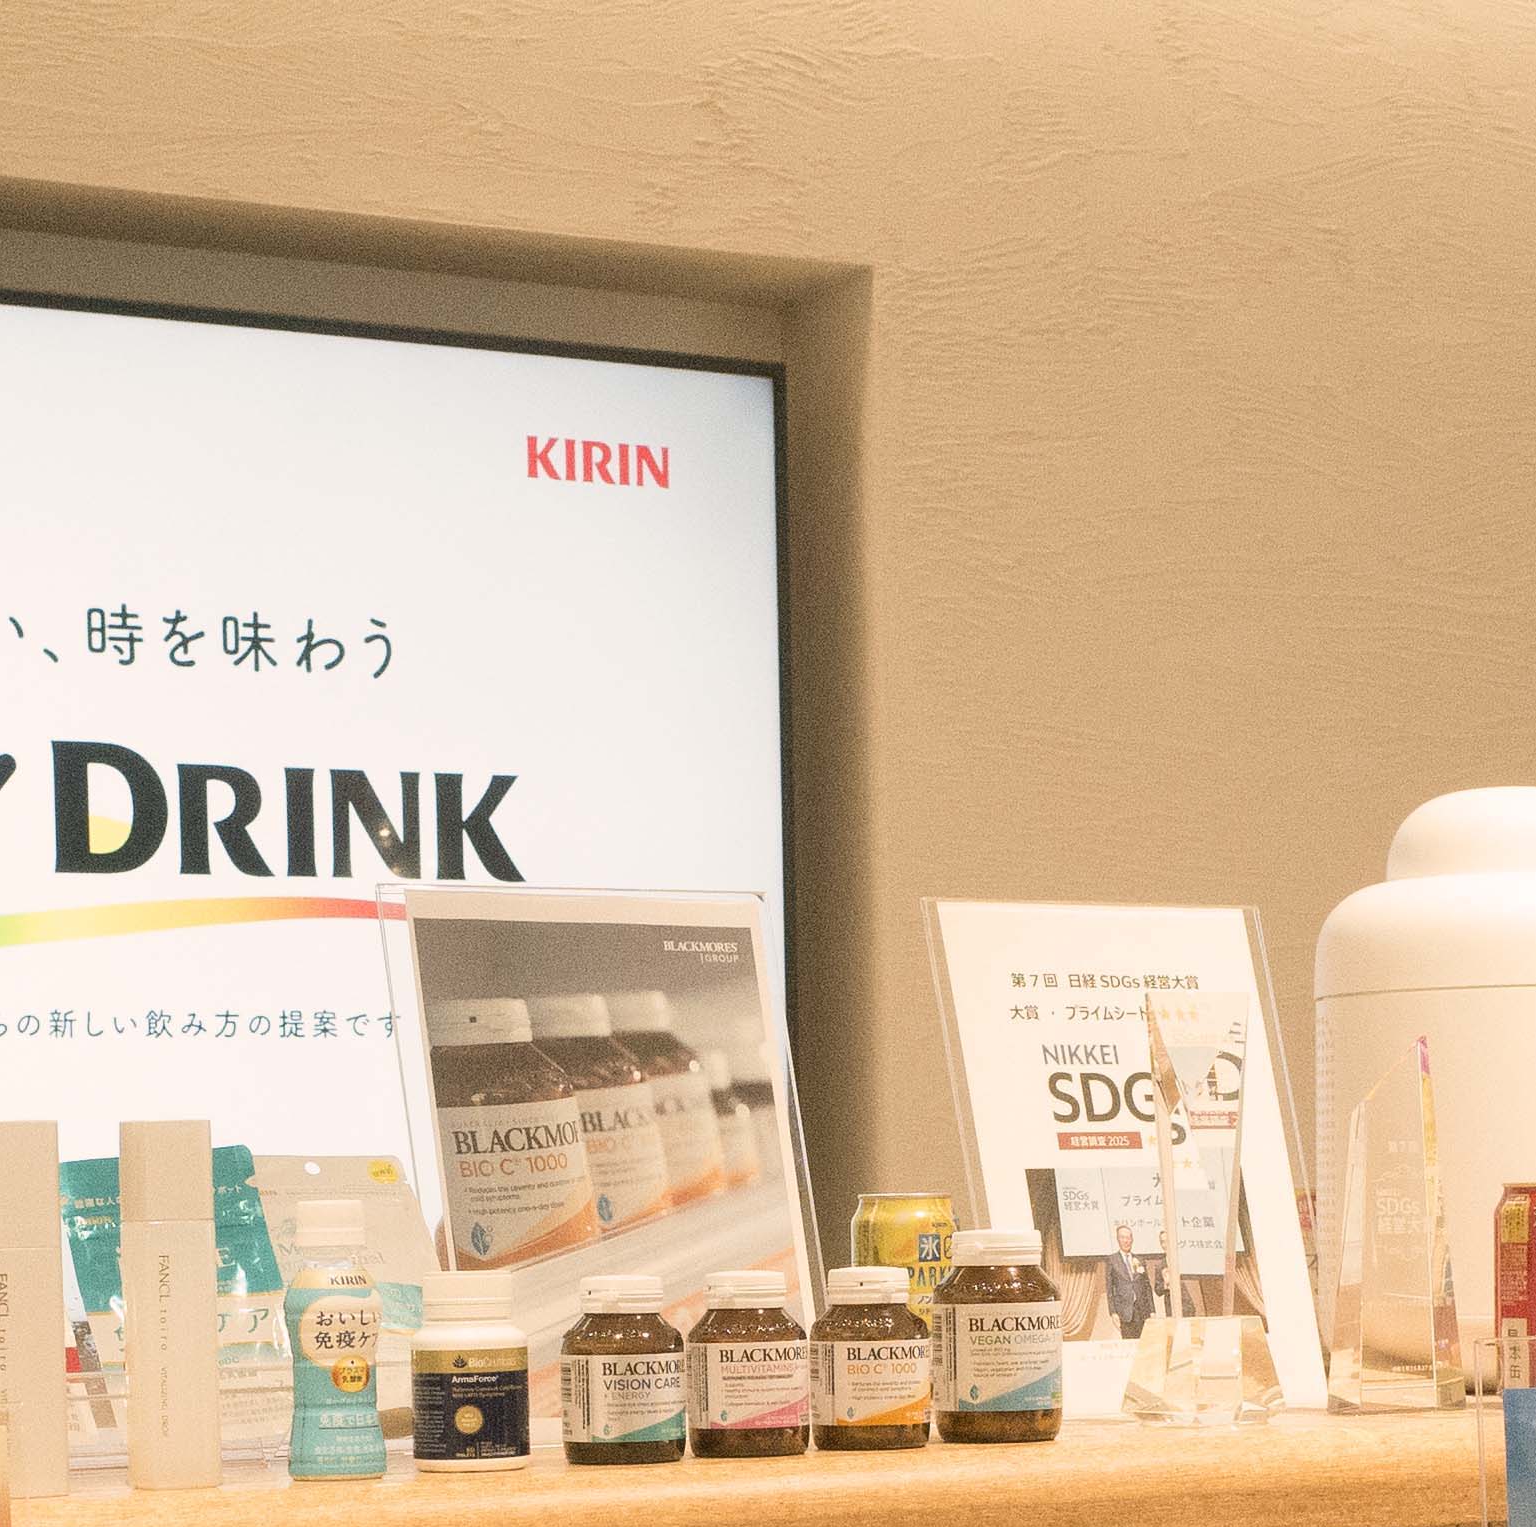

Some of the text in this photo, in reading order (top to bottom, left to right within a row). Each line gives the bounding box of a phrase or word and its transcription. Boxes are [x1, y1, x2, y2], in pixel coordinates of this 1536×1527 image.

[525, 433, 670, 490] KIRIN
[53, 739, 527, 882] DRINK
[663, 939, 739, 955] BLACKMORES
[704, 953, 740, 963] GROUP
[1068, 974, 1097, 990] 日経
[1100, 974, 1141, 991] SDGs
[1041, 1044, 1120, 1066] NIKKEI
[459, 1158, 496, 1179] BIO
[526, 1152, 569, 1174] 1000
[919, 1235, 941, 1260] 氷
[158, 1254, 171, 1302] FANCL
[329, 1275, 368, 1286] KIRIN
[969, 1334, 1012, 1346] VEGAN
[847, 1364, 870, 1375] BIO
[889, 1362, 918, 1375] 1000
[451, 1373, 497, 1384] ArmaForce
[603, 1376, 681, 1391] VISION CARE
